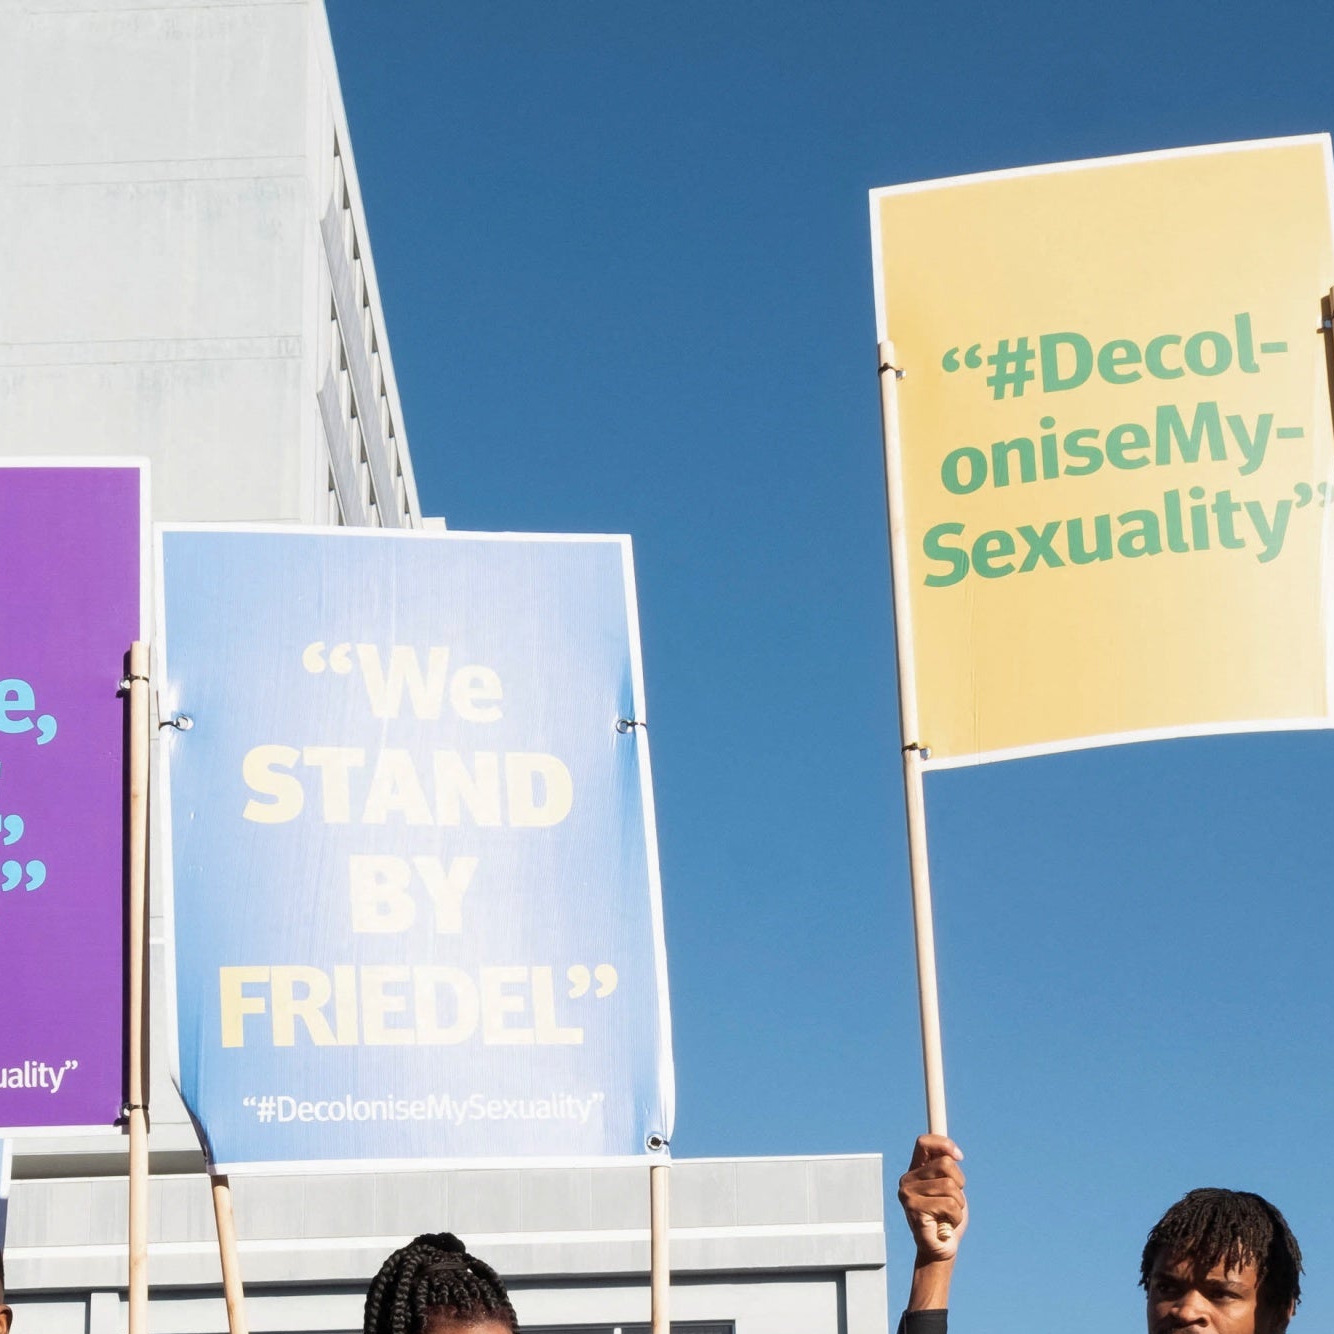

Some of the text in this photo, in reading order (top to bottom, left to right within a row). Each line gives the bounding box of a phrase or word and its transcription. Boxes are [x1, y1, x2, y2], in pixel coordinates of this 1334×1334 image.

[941, 312, 1288, 400] “#Decol-
[940, 401, 1304, 496] oniseMy-
[302, 642, 504, 723] “We
[242, 744, 574, 827] STAND
[348, 854, 479, 934] BY
[218, 964, 619, 1048] FRIEDEL”
[242, 1092, 605, 1127] “#DecoloniseMySexuality”
